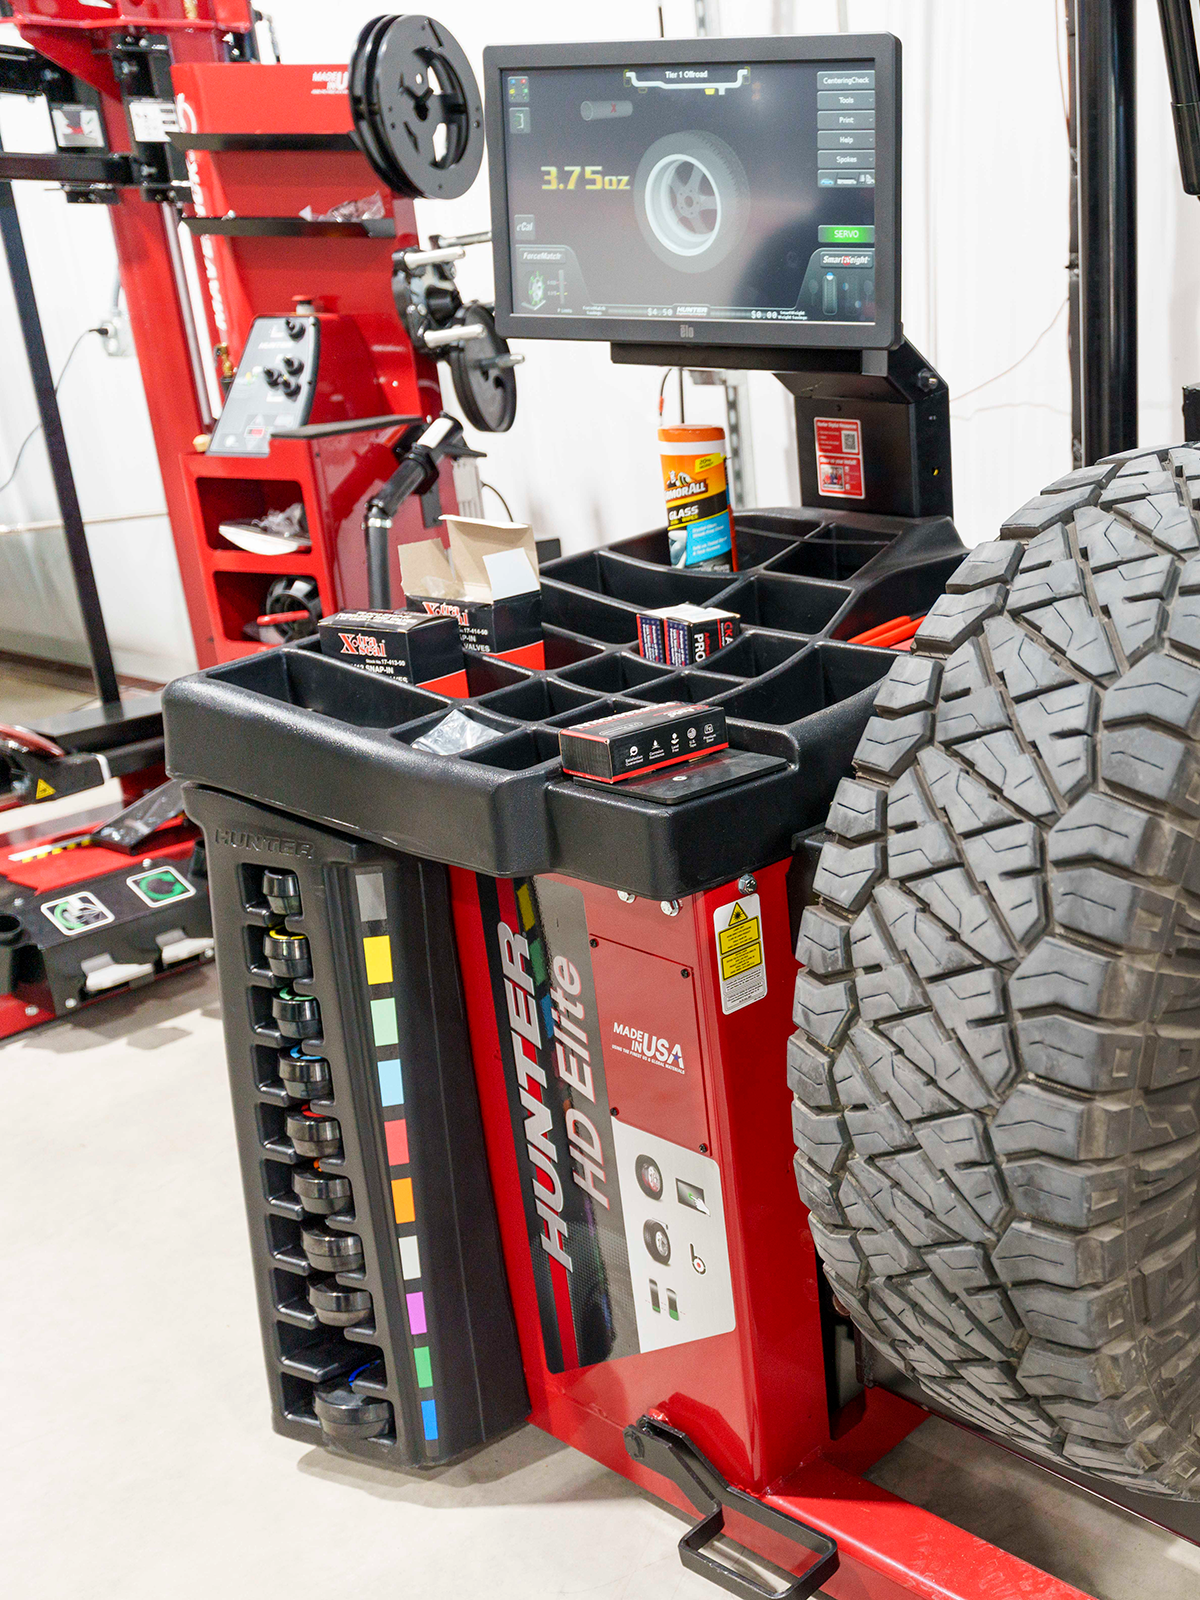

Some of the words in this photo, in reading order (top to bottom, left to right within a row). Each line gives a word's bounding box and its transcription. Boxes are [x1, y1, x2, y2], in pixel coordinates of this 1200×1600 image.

[665, 71, 678, 79] Tier
[683, 70, 708, 79] Offroad
[823, 76, 870, 85] CenteringCheck
[838, 96, 854, 104] Tools
[838, 116, 854, 124] Print
[839, 136, 854, 144] Help
[836, 155, 857, 164] Spokes
[834, 229, 860, 238] SERVO
[522, 252, 563, 261] ForceMatch
[823, 255, 870, 266] SmartWeight
[647, 307, 673, 317] $4.50
[676, 306, 708, 314] HUNTER
[751, 310, 778, 319] $0.00
[668, 505, 699, 521] GLASS
[338, 632, 377, 655] Xtra
[463, 643, 491, 653] VALVES
[694, 632, 706, 663] PRO
[358, 642, 387, 657] seal
[365, 664, 394, 675] SNAP-IN
[215, 828, 315, 859] HUNTER
[550, 954, 597, 1105] Elite
[613, 1022, 644, 1042] MADE
[631, 1040, 642, 1053] IN
[643, 1032, 685, 1070] USA
[497, 920, 574, 1273] HUNTER
[564, 1107, 611, 1211] HD
